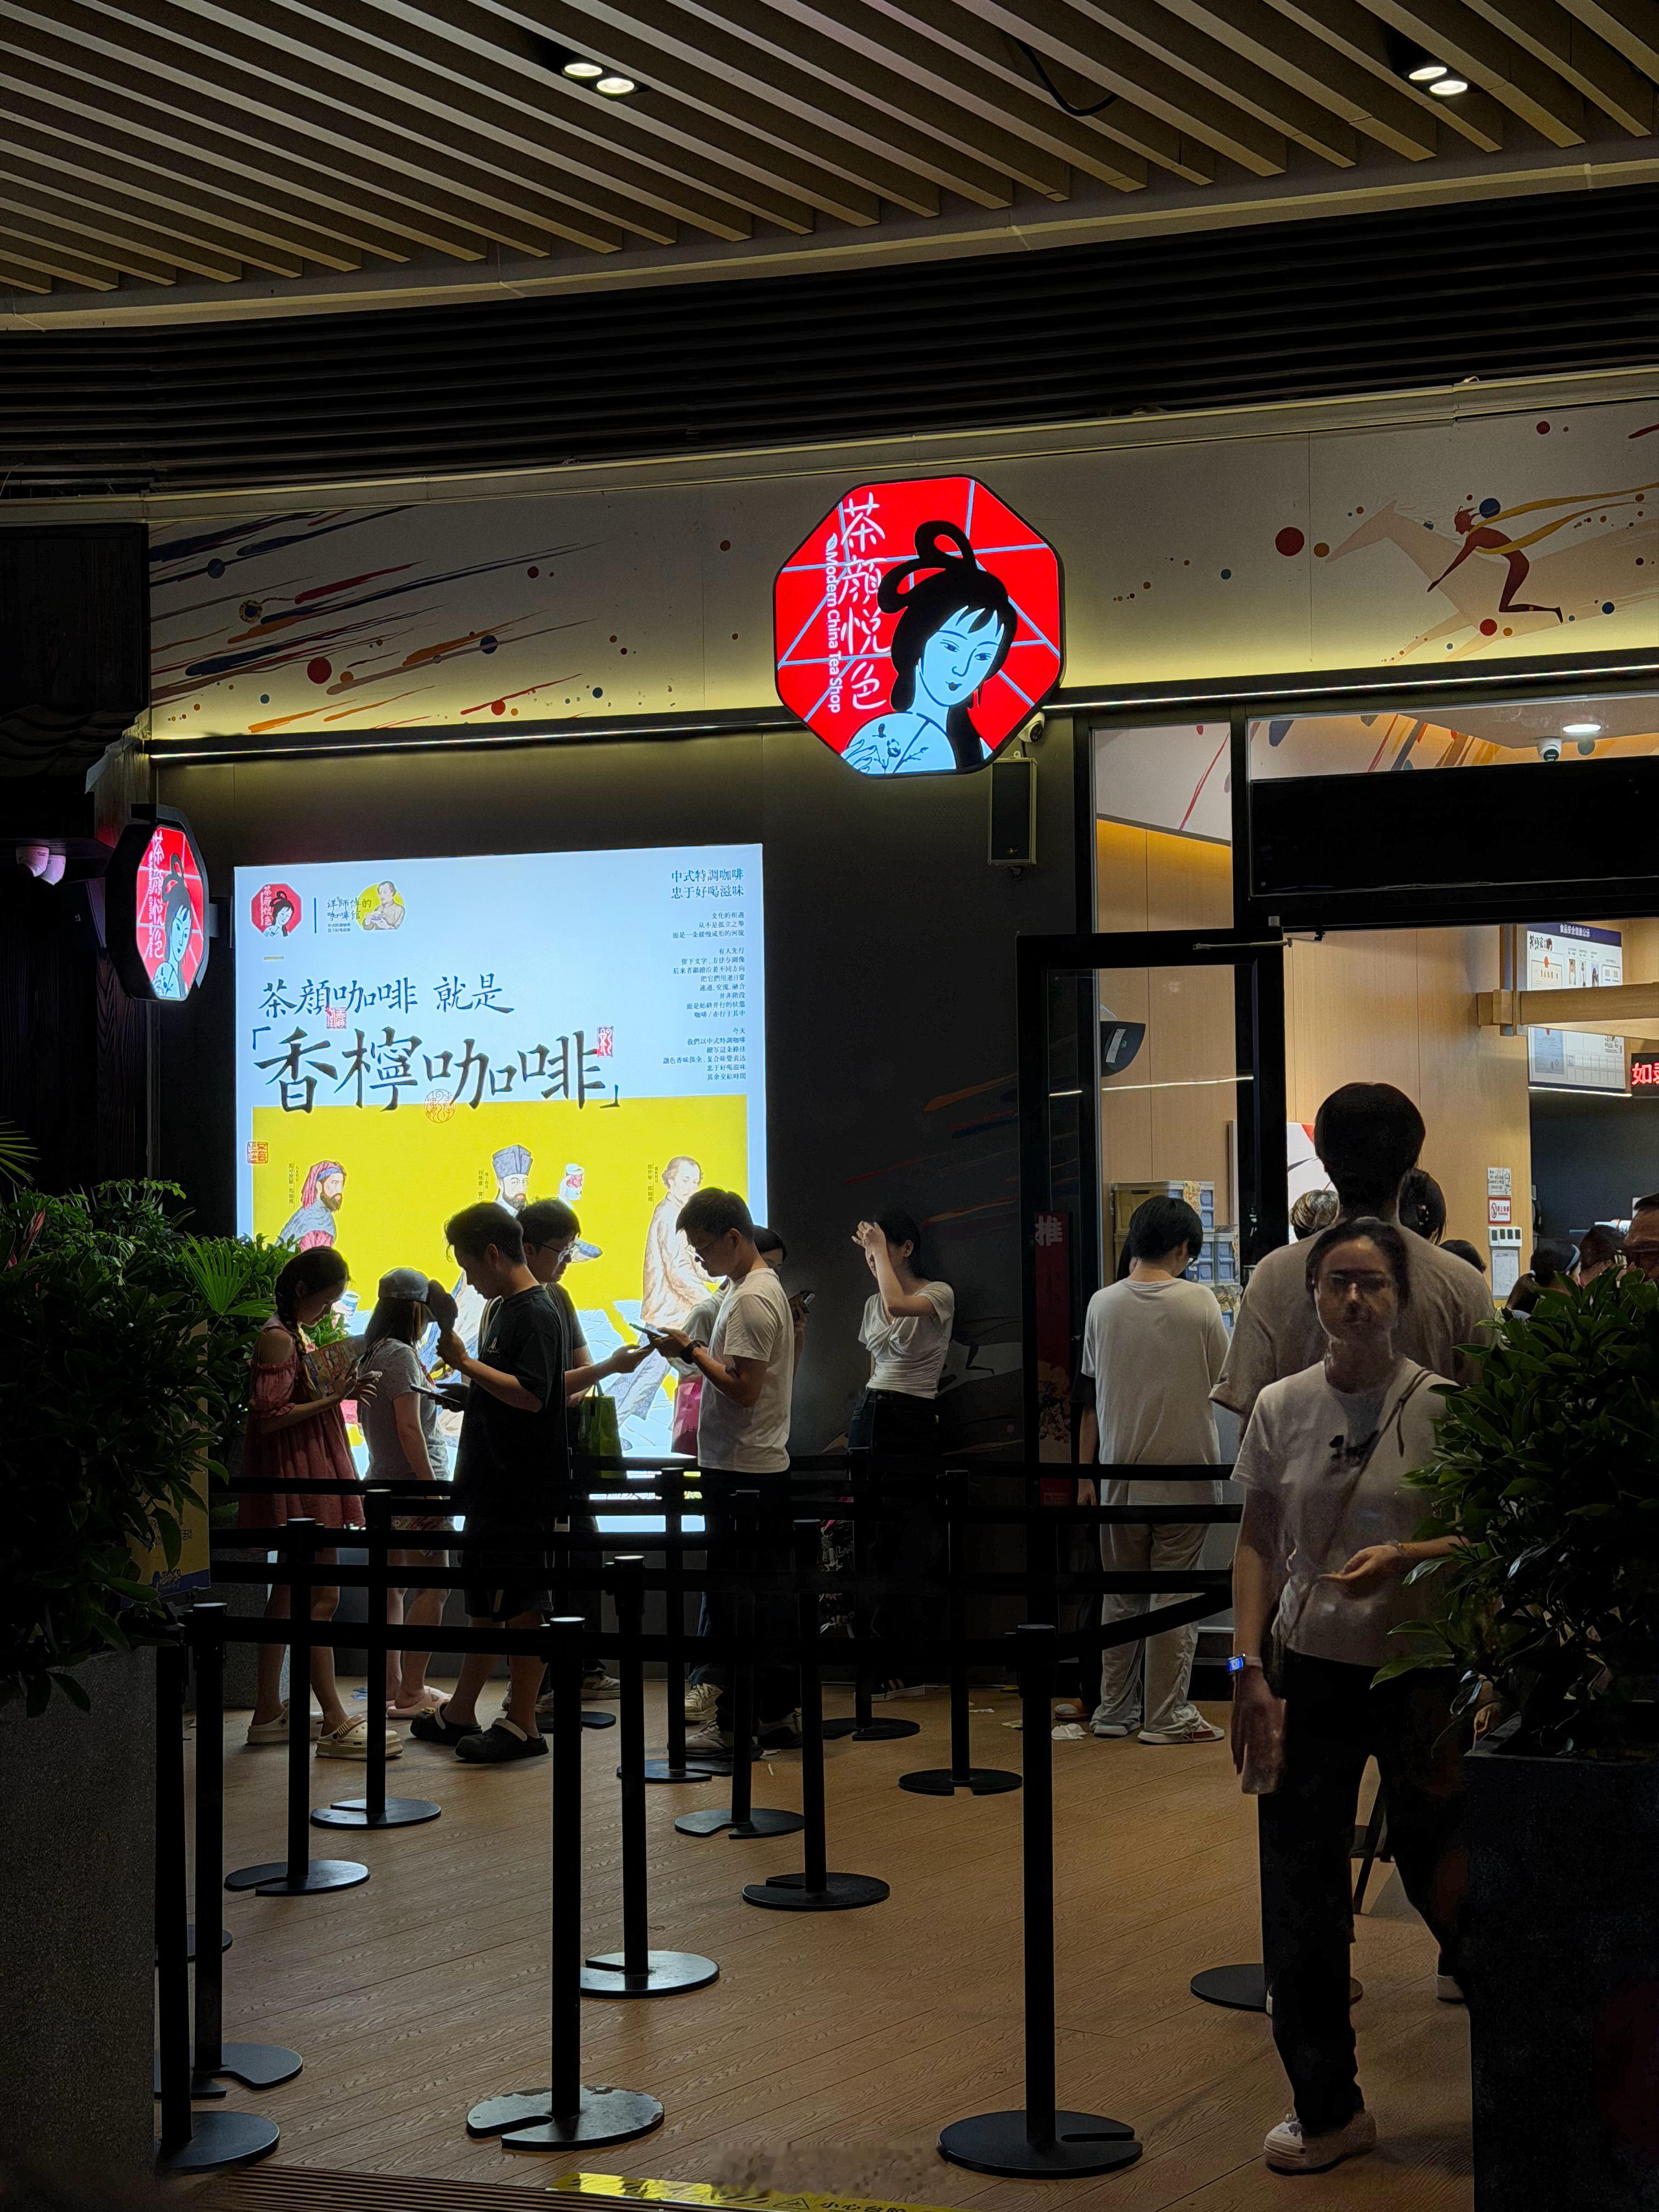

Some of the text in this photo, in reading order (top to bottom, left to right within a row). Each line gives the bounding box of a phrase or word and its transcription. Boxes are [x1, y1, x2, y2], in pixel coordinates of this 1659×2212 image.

[825, 548, 843, 714] Modern China Tea Shop
[671, 884, 744, 899] 忠于好喝滋味
[672, 868, 744, 883] 中式特調咖啡
[433, 973, 514, 1014] 就是
[1035, 1215, 1063, 1247] 推
